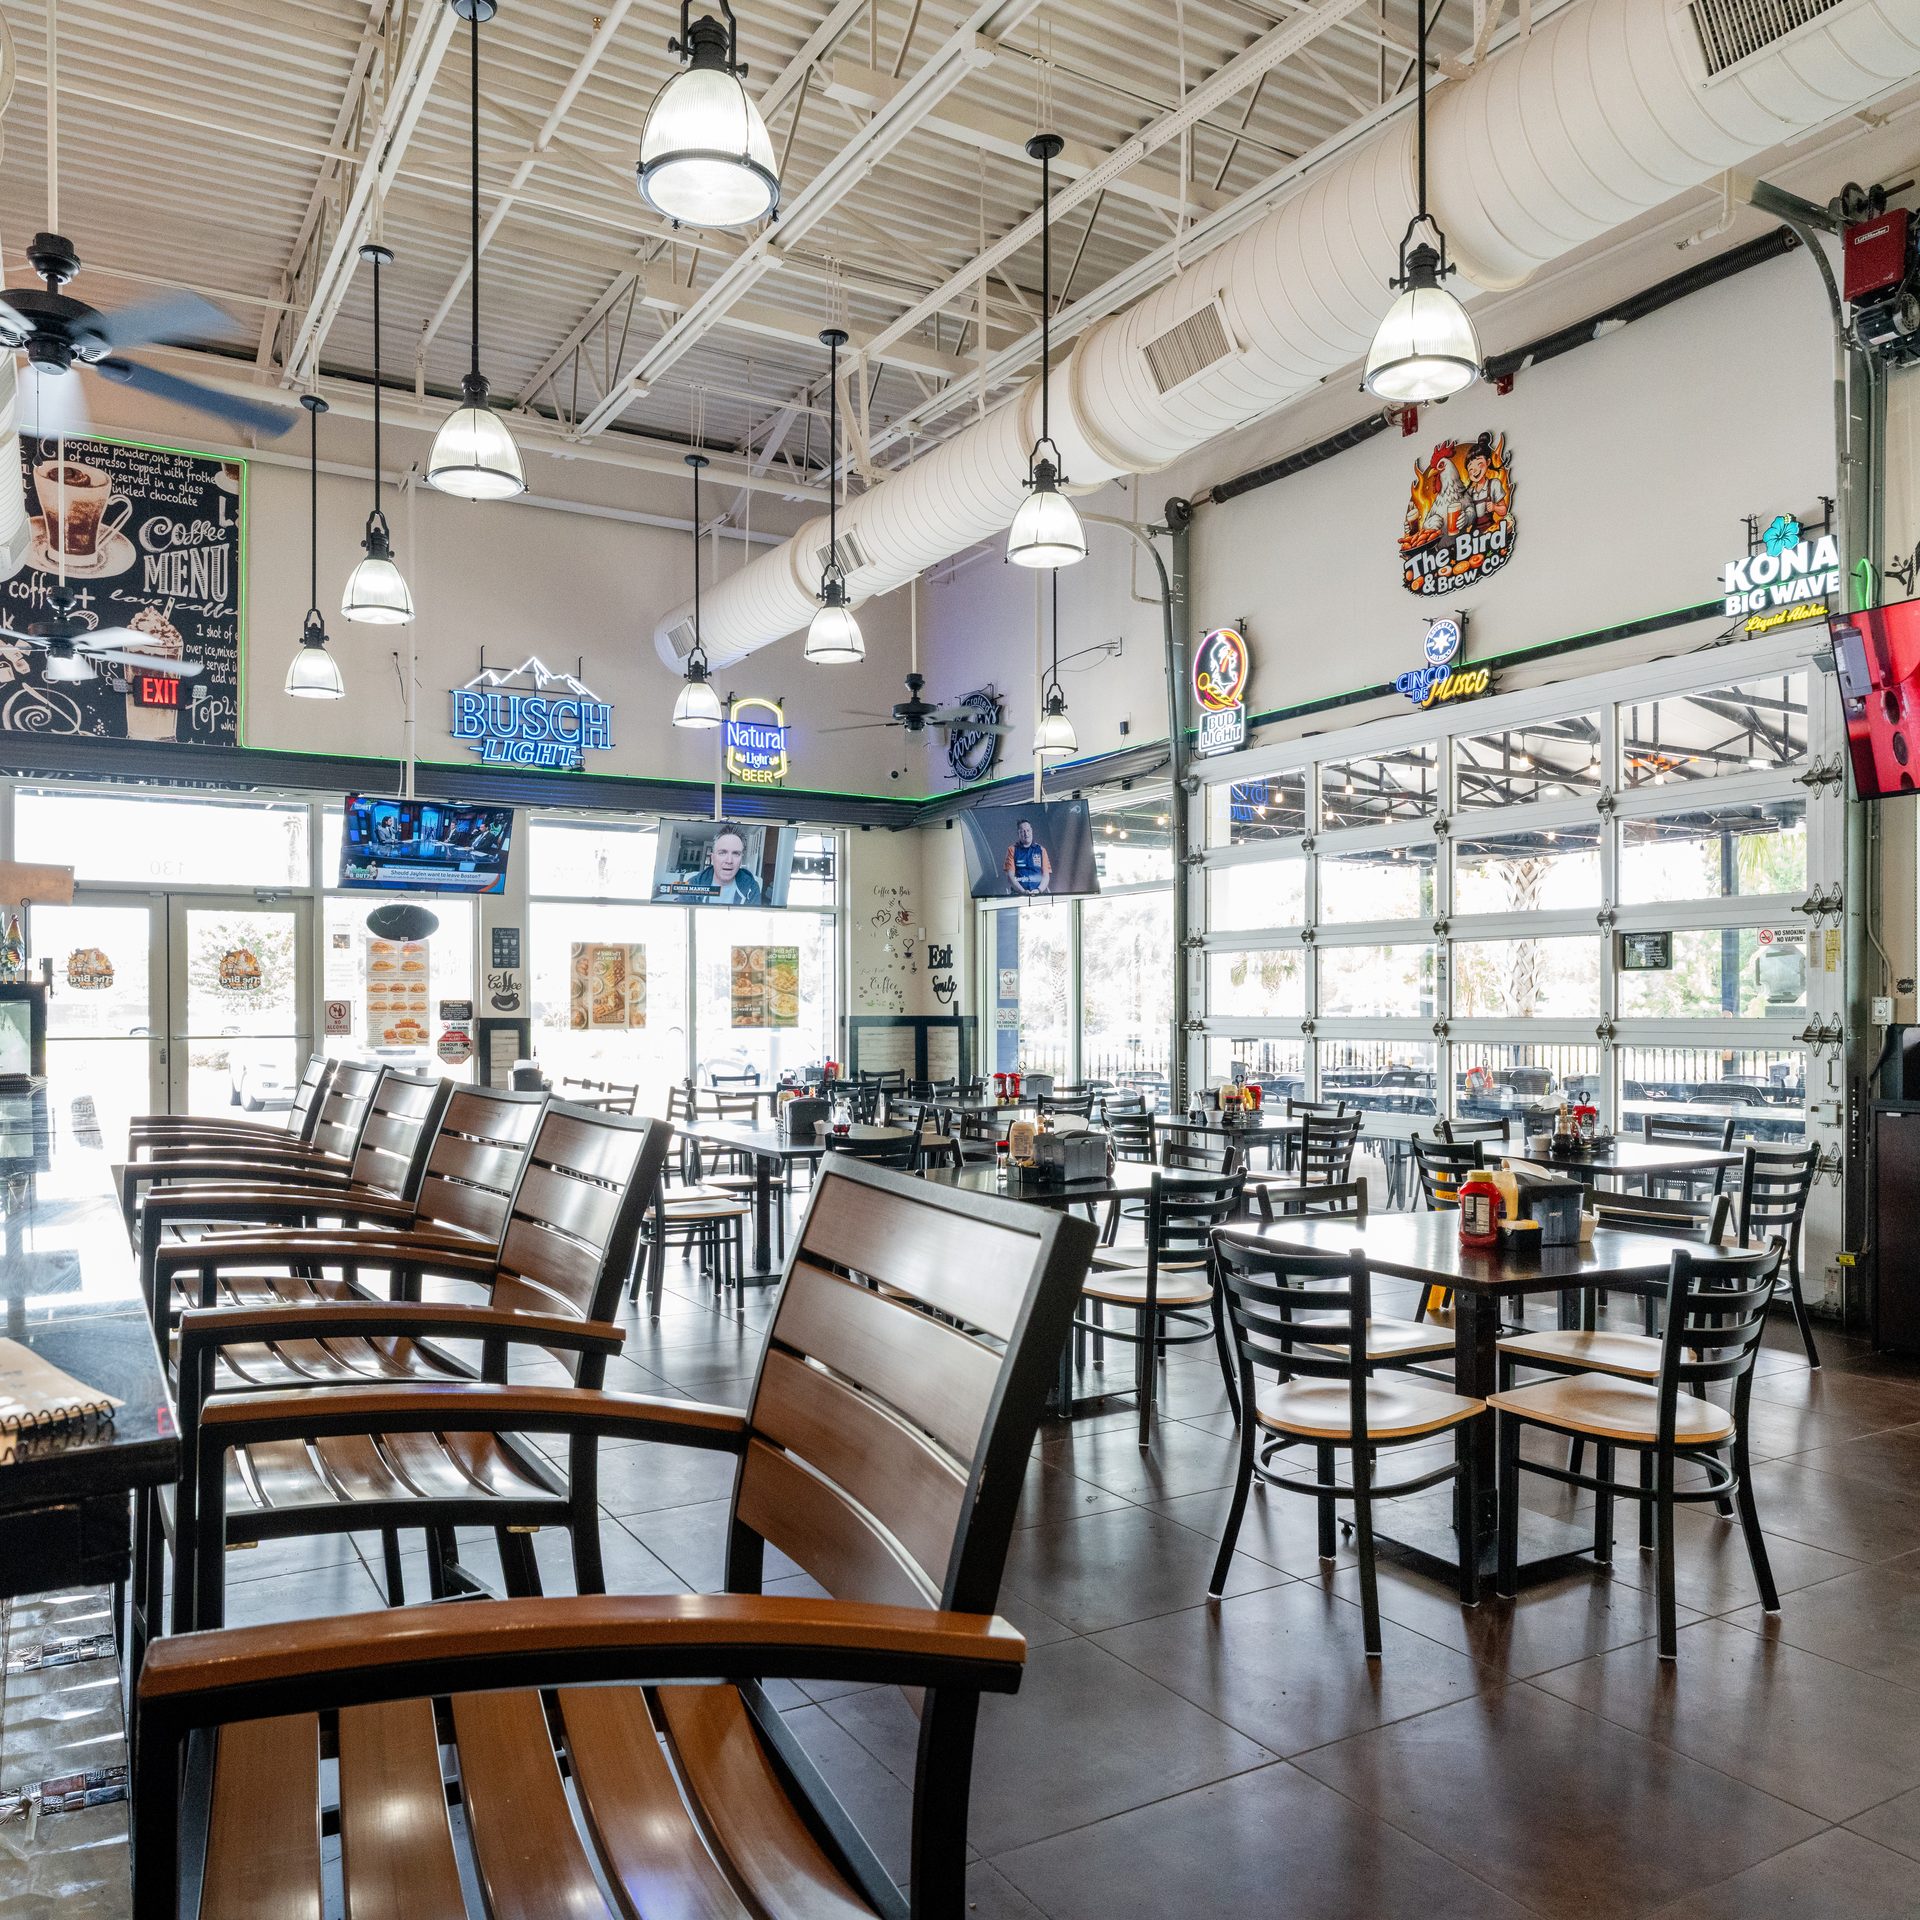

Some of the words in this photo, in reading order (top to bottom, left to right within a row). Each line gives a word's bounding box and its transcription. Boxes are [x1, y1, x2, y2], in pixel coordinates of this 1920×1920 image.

[69, 452, 81, 463] of
[85, 457, 127, 471] espresso
[129, 461, 162, 479] topped
[164, 468, 184, 480] with
[174, 457, 194, 469] shot
[150, 490, 198, 507] chocolate
[154, 478, 165, 489] in
[168, 481, 175, 490] a
[179, 482, 204, 496] glass
[139, 517, 227, 552] Coffee
[1405, 549, 1450, 580] The
[1456, 520, 1507, 561] Bird
[143, 543, 229, 603] MENU
[1423, 573, 1436, 594] &
[1438, 568, 1478, 593] Brew
[1481, 553, 1505, 574] Co.
[1725, 534, 1839, 594] KONA
[1726, 588, 1767, 617] BIG
[1769, 571, 1839, 606] WAVE
[206, 625, 221, 638] shot
[1745, 609, 1788, 632] Liquid
[185, 643, 201, 653] over
[206, 662, 230, 677] served
[211, 674, 226, 684] add
[1396, 665, 1450, 693] CINCO
[142, 677, 179, 704] EXIT
[1412, 687, 1429, 704] DE
[1421, 668, 1489, 708] JALISCO
[453, 689, 612, 750] BUSCH
[1207, 711, 1236, 731] BUD
[728, 722, 786, 751] Natural
[1201, 726, 1241, 748] LIGHT
[482, 738, 577, 767] LIGHT
[742, 768, 773, 784] BEER
[927, 944, 953, 969] Eat
